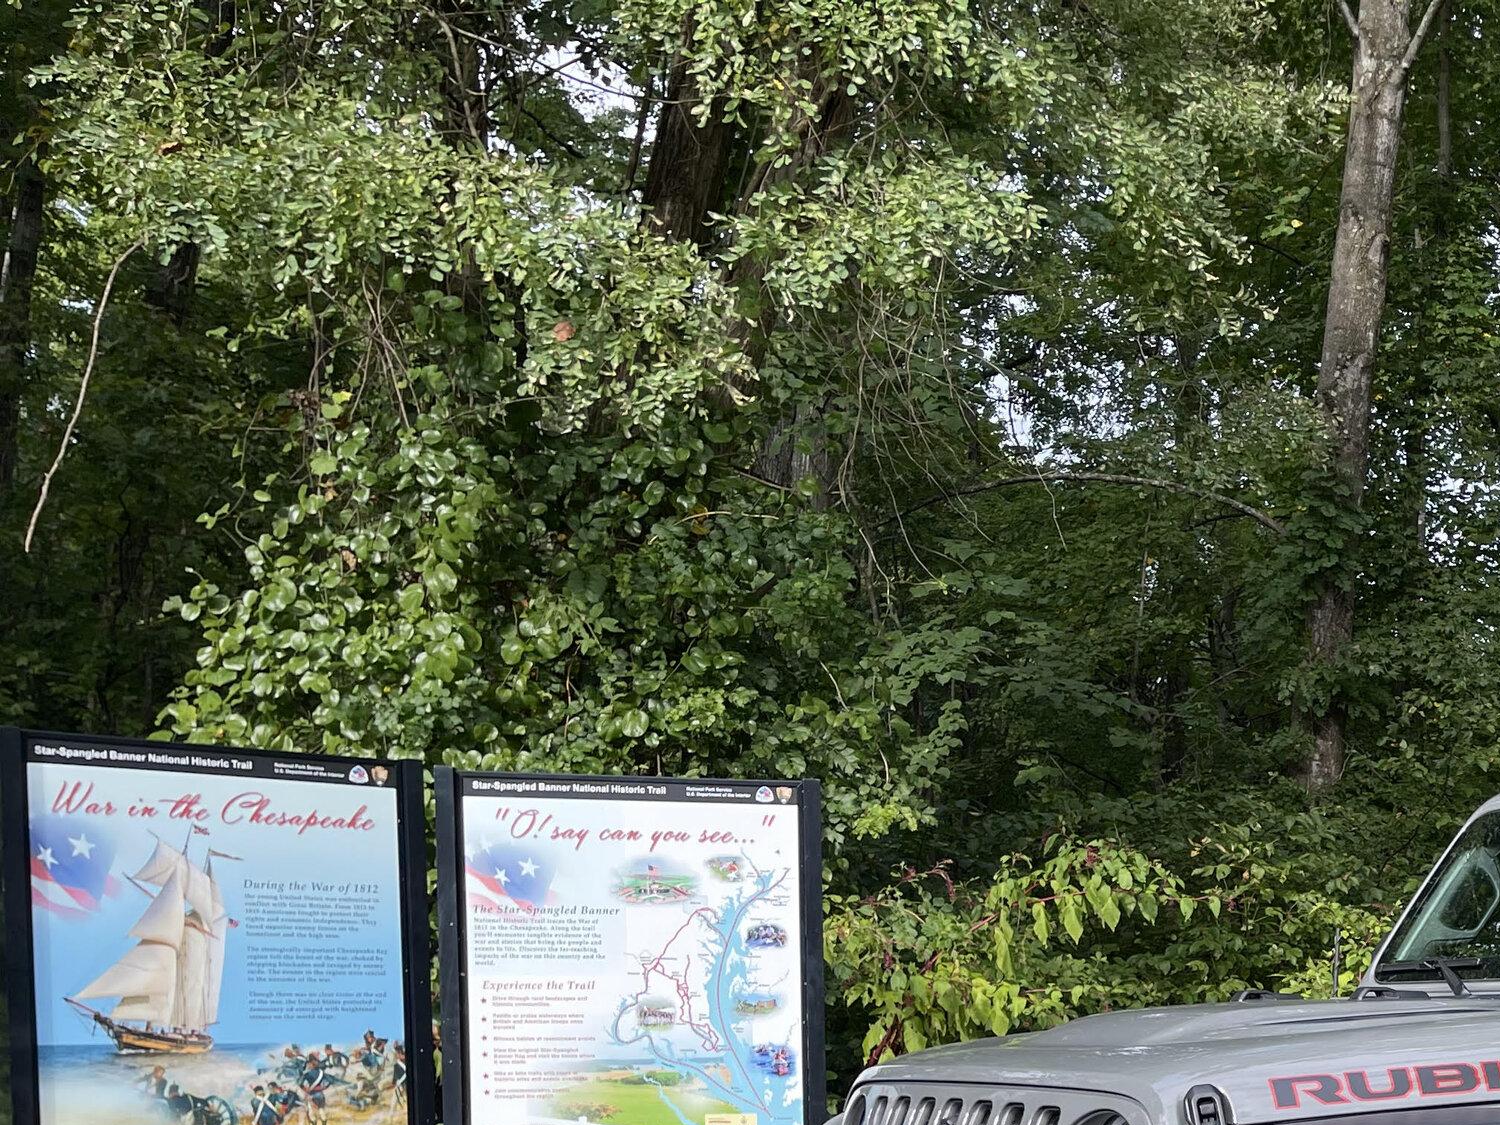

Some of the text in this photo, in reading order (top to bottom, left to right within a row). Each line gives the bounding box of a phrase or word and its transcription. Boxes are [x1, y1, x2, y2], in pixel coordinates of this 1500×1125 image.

[34, 745, 252, 770] Star-Spangled Banner National Historic Trail
[472, 781, 666, 794] Star-Spangled Banner National Historic Trail
[52, 780, 375, 834] War in the Chesapeake
[551, 827, 589, 850] say
[600, 828, 642, 841] can
[650, 829, 690, 852] you
[244, 879, 379, 895] During the War of 1812
[473, 905, 620, 916] The Star-Spangled Banner
[483, 981, 595, 992] Experience the Trail
